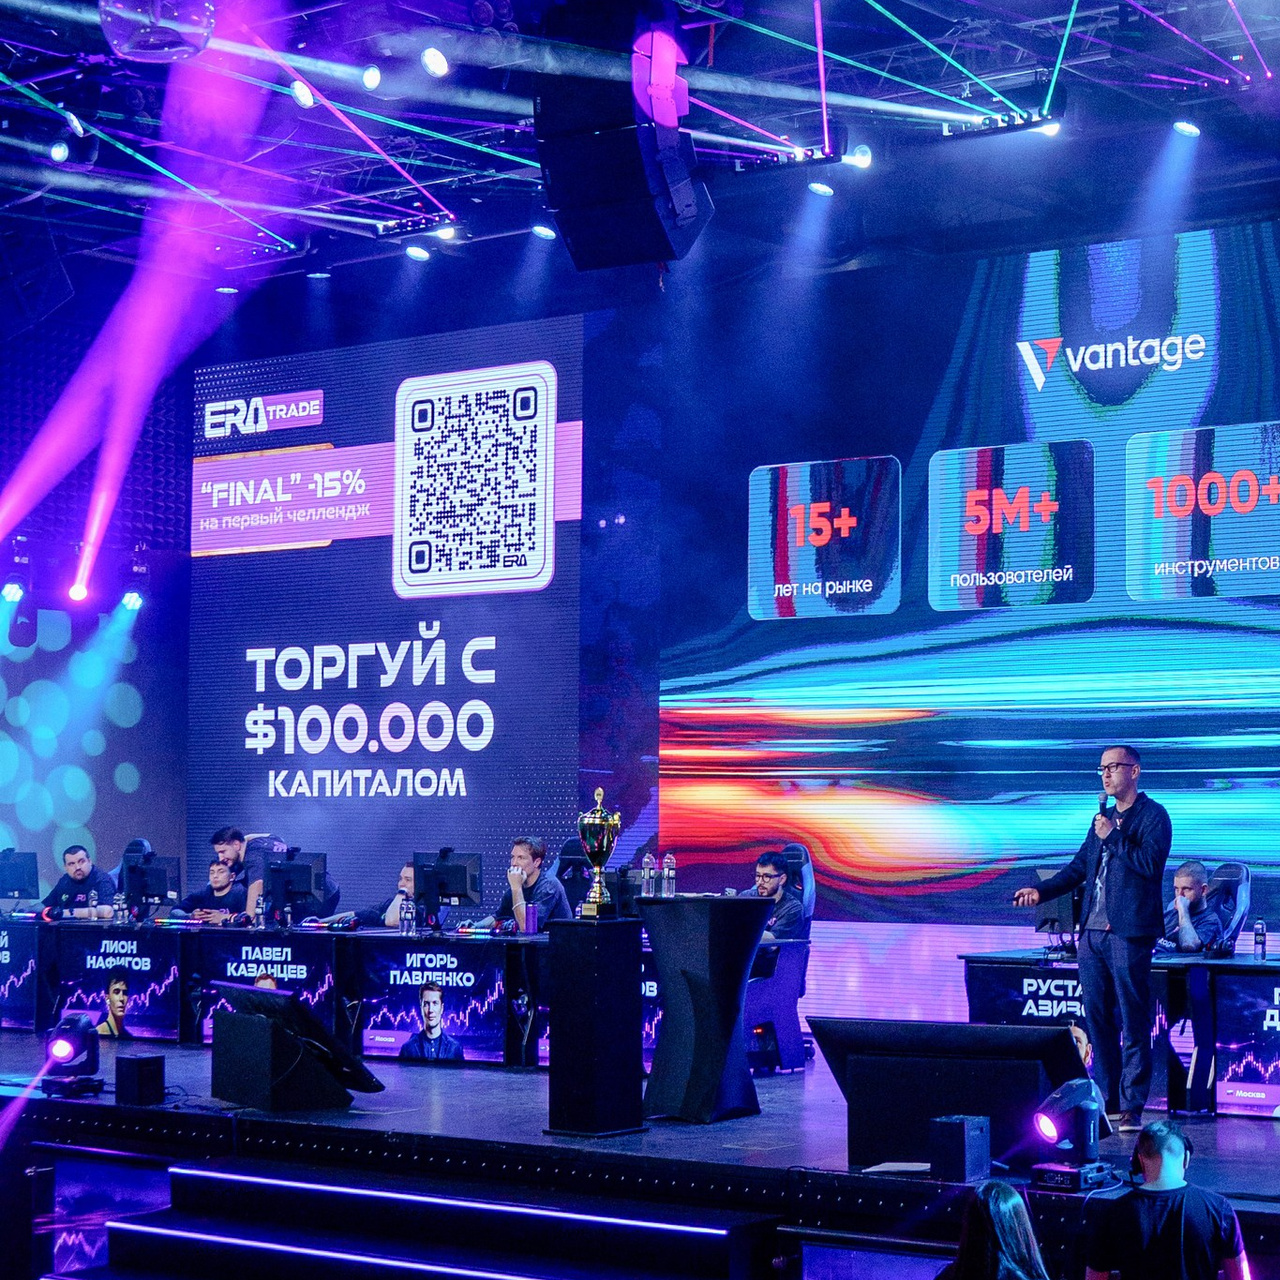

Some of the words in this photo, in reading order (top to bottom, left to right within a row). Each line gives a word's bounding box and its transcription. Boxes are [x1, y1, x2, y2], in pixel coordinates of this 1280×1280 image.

[1066, 334, 1206, 372] vantage
[203, 396, 268, 438] ERA
[266, 400, 320, 420] TRADE
[308, 469, 367, 498] -15%
[200, 517, 219, 531] на
[222, 506, 284, 531] первый
[287, 503, 371, 522] челлендж
[789, 501, 857, 547] 15+
[503, 554, 527, 568] ERA
[1154, 555, 1280, 578] инструментов
[950, 564, 1074, 587] пользователей
[774, 583, 799, 597] лет
[802, 582, 822, 596] на
[825, 578, 874, 598] рынке
[246, 621, 446, 692] ТОРГУЙ
[245, 699, 495, 755] $100.000
[268, 768, 467, 798] КАПИТАЛОМ
[100, 940, 137, 954] ЛИОН
[241, 946, 291, 961] ПАВЕЛ
[86, 955, 151, 971] НАФИГОВ
[227, 962, 307, 982] КАЗАНЦЕВ
[405, 953, 458, 969] ИГОРЬ
[389, 970, 475, 987] ПАВЛЕНКО
